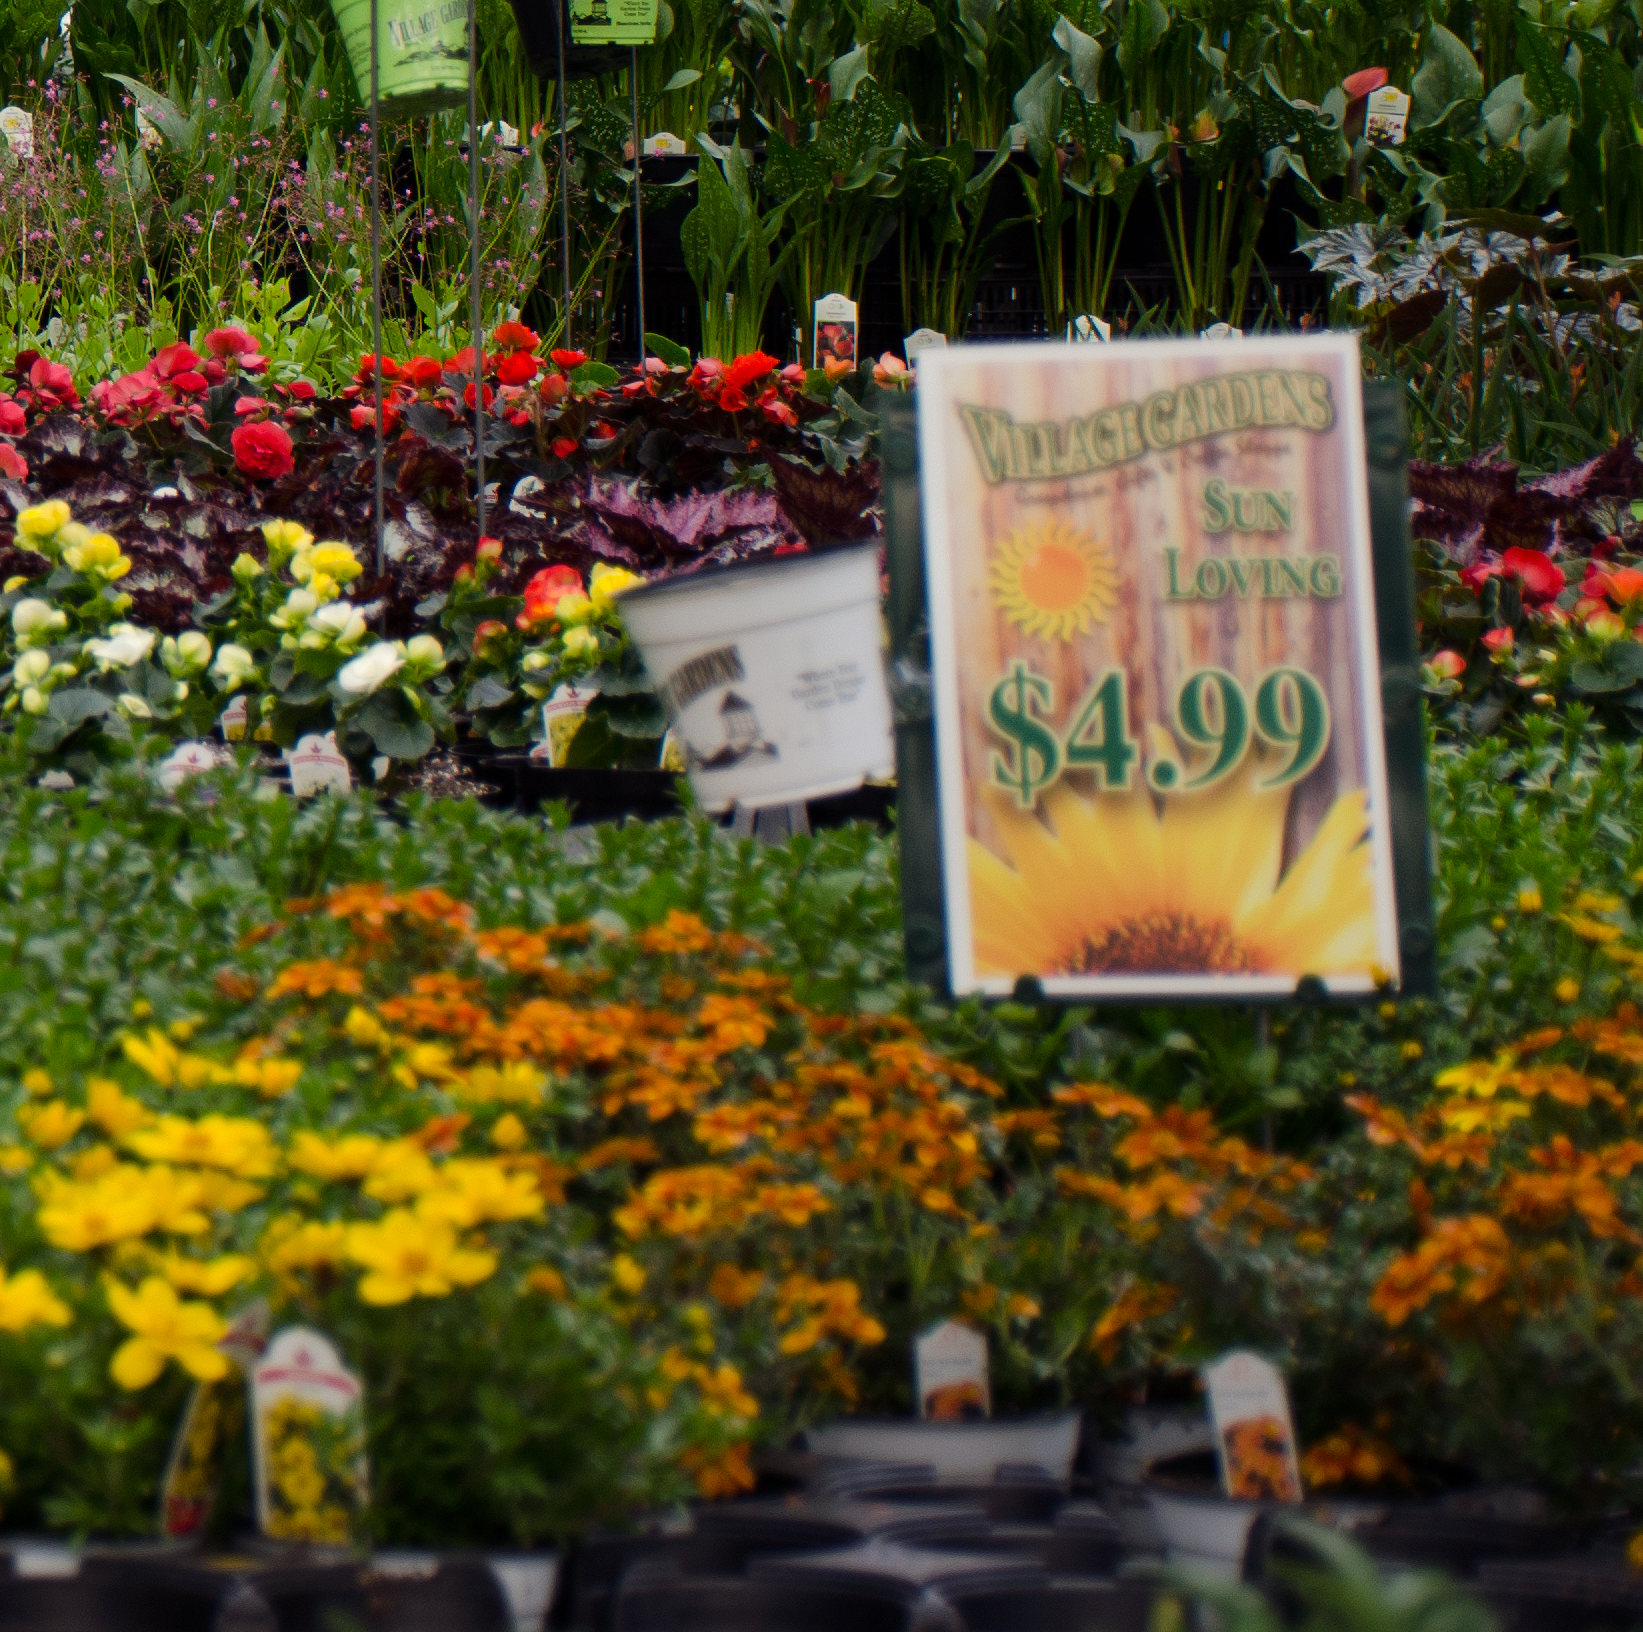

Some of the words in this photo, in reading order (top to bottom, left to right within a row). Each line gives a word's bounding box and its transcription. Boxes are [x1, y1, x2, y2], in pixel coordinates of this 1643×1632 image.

[959, 403, 1146, 485] VILLAGE
[1142, 370, 1336, 451] GARDENS
[1201, 476, 1294, 534] SUN
[1162, 544, 1344, 602] LOVING
[986, 657, 1332, 810] $4.99
